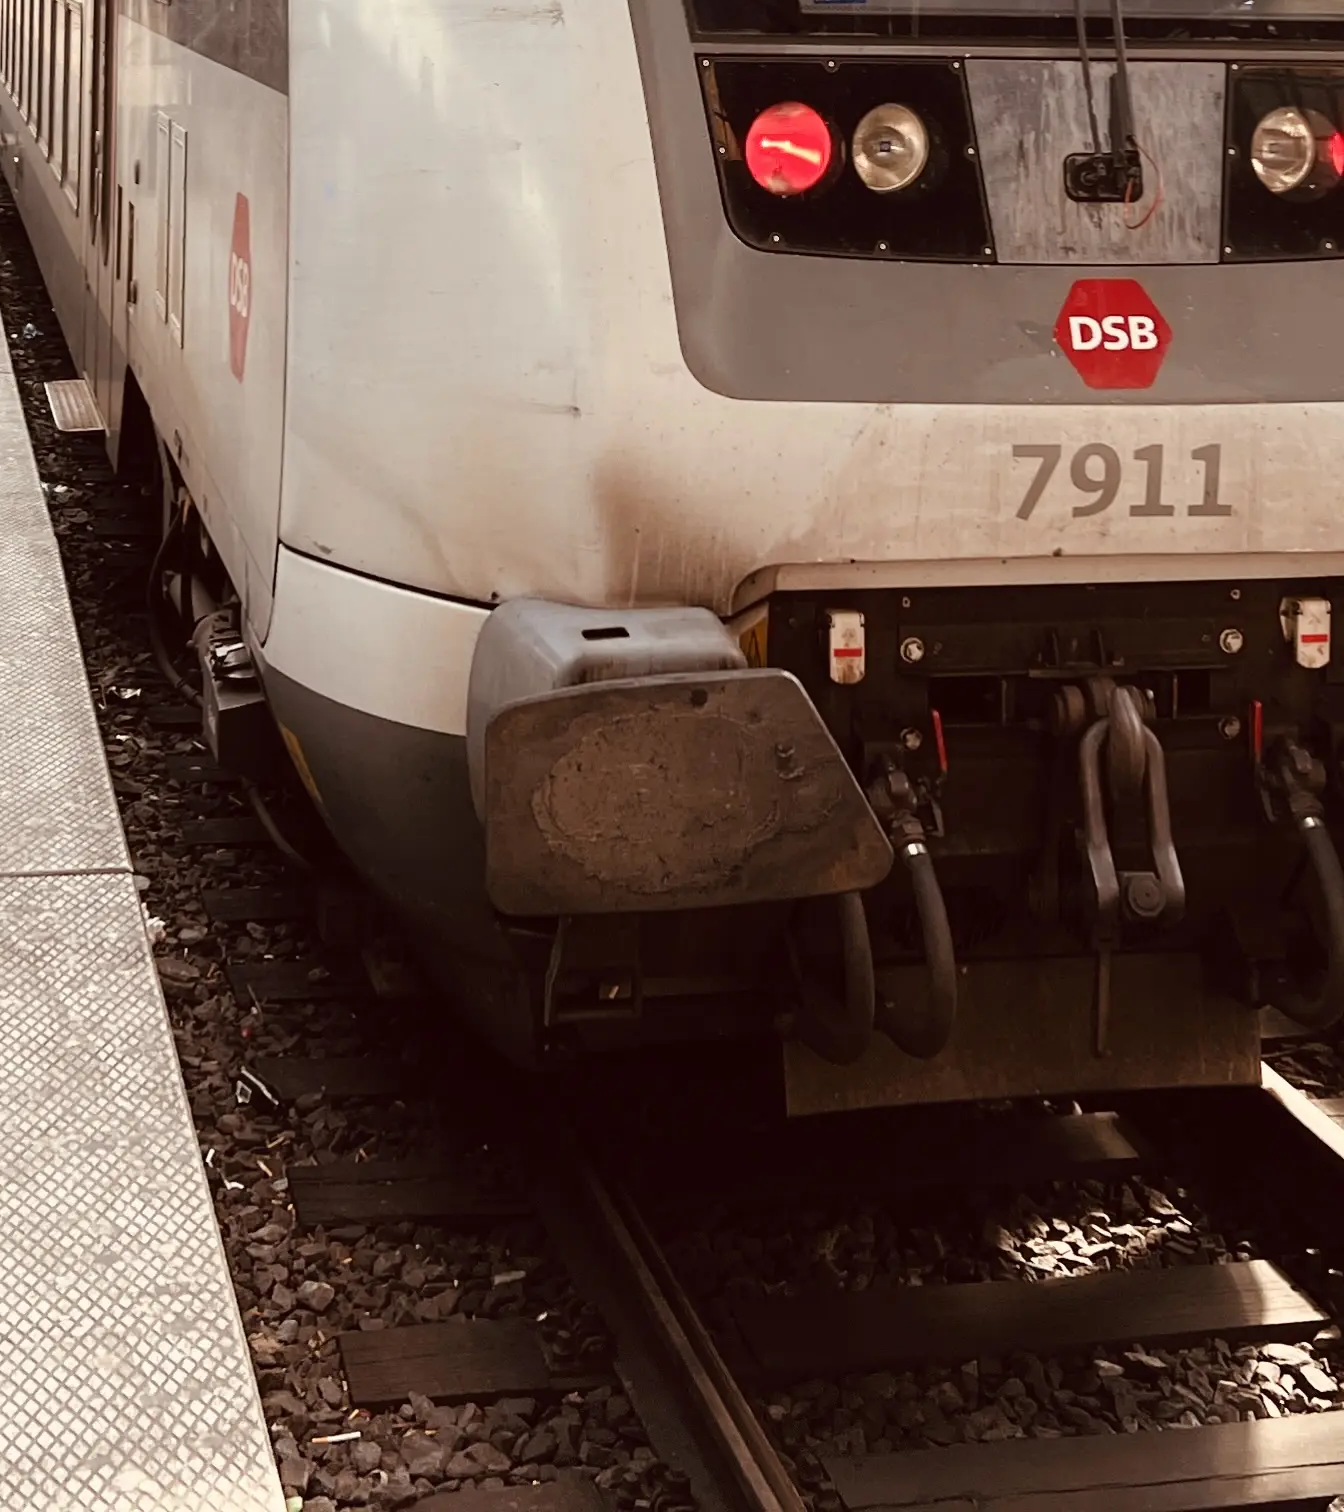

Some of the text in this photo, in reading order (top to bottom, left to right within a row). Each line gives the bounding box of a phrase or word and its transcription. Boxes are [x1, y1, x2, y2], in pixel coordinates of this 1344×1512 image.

[231, 251, 250, 318] DSB
[1068, 315, 1159, 352] DSB
[1011, 442, 1233, 521] 7911
